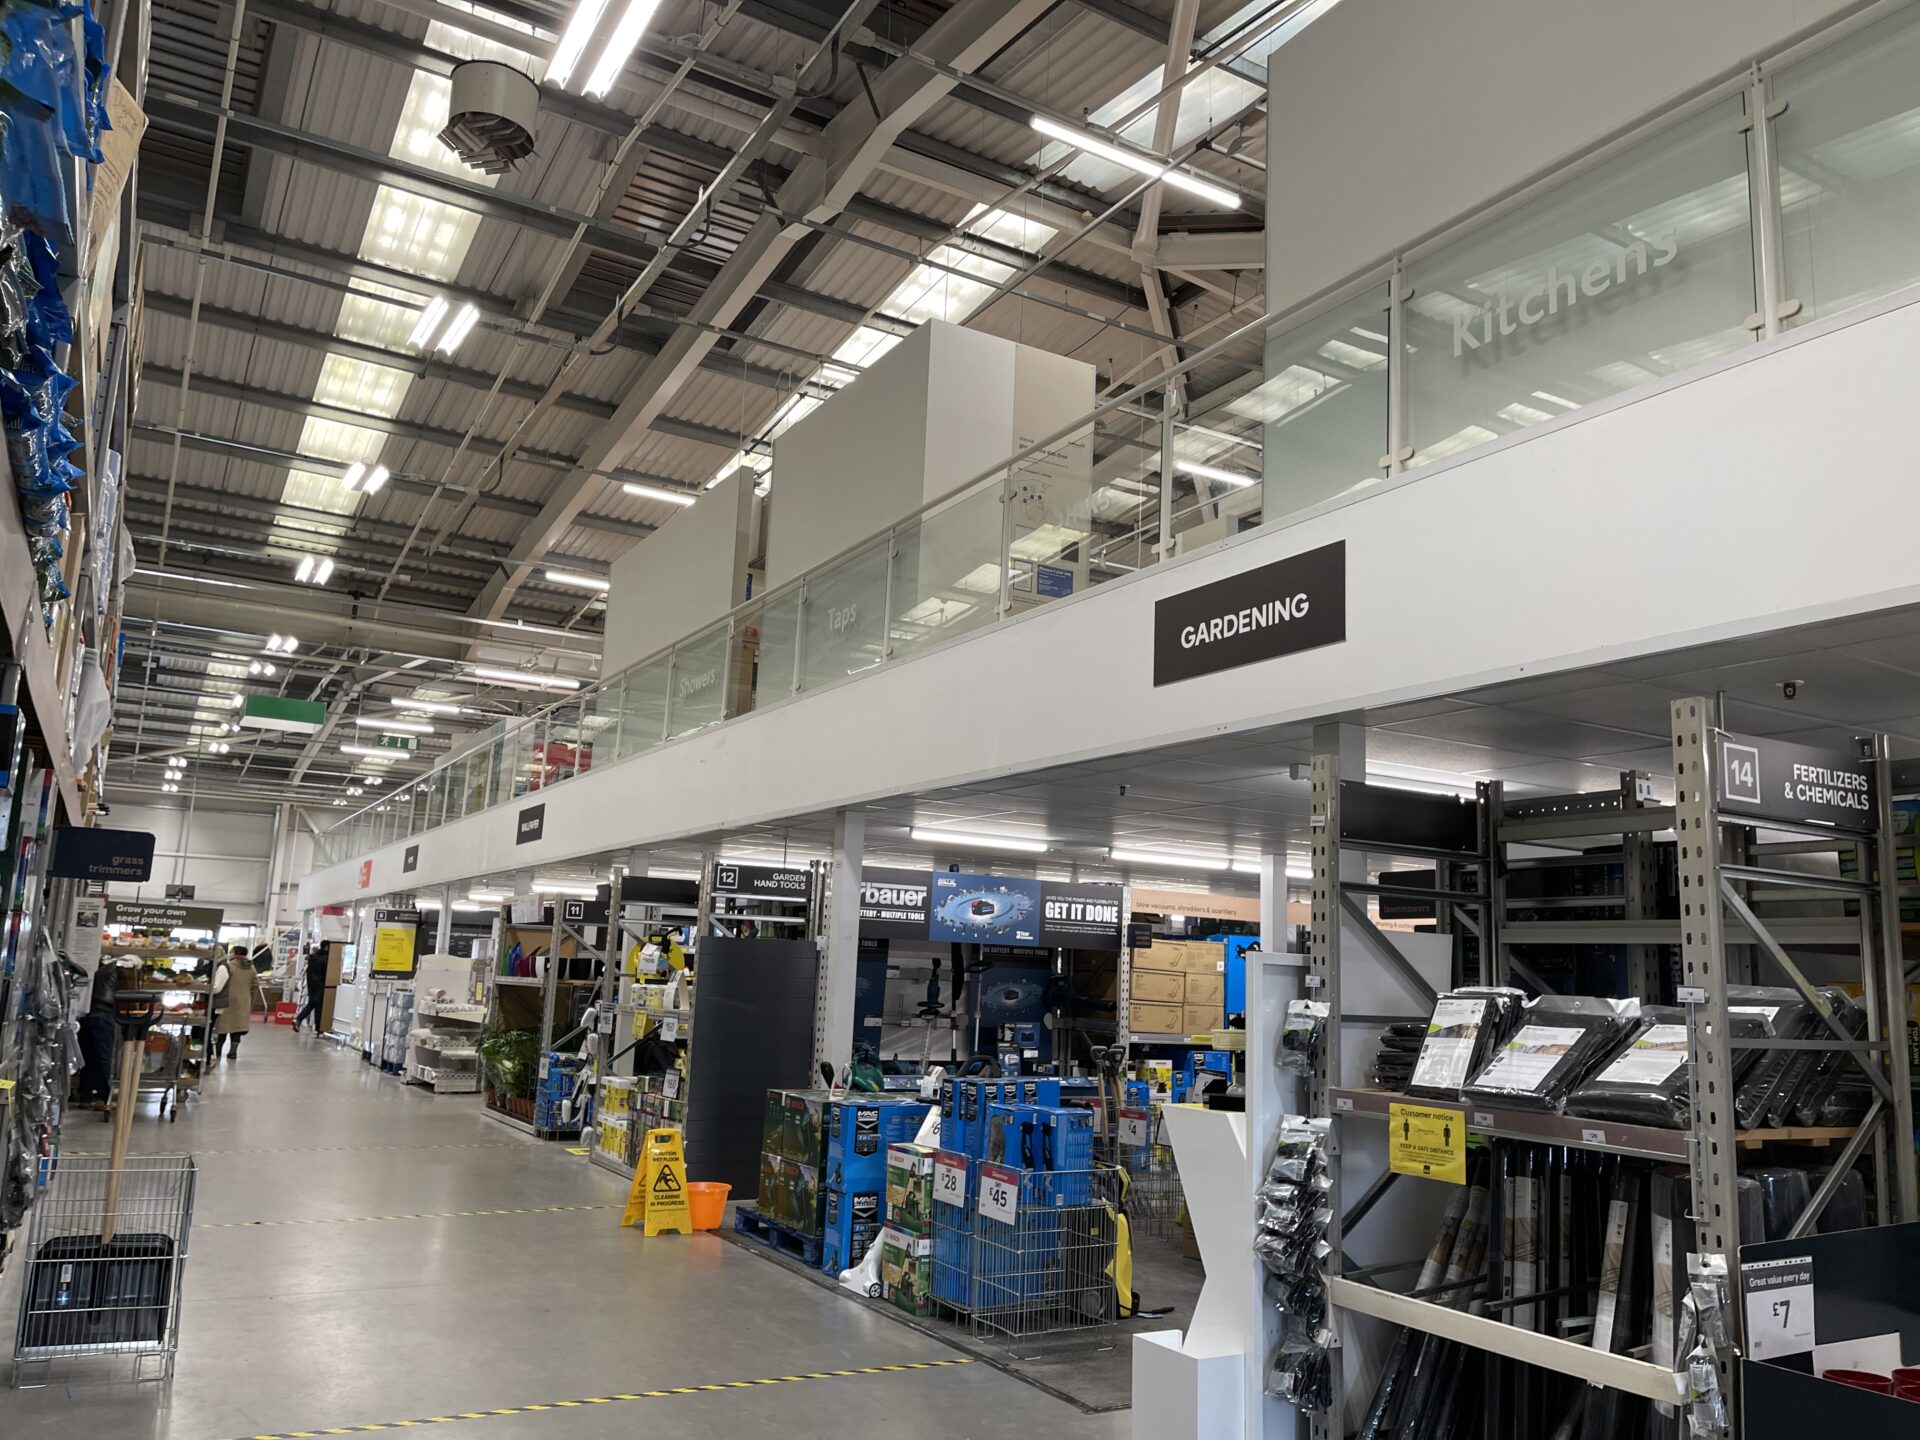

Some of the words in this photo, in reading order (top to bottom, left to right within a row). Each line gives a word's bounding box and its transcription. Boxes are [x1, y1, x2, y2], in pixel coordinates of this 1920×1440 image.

[1453, 227, 1678, 358] Kitchens
[827, 603, 857, 633] Taps
[1181, 593, 1309, 649] GARDENING
[679, 668, 716, 698] Showers
[1731, 760, 1753, 787] 14
[1793, 763, 1868, 791] FERTILIZERS
[1784, 782, 1794, 799] &
[1796, 785, 1870, 811] CHEMICALS
[112, 856, 144, 866] grass
[89, 864, 143, 876] trimmers
[720, 872, 735, 884] 12
[772, 873, 806, 882] GARDEN
[753, 880, 778, 888] HAND
[779, 881, 806, 890] TOOLS
[116, 904, 142, 914] Grow
[143, 906, 165, 916] your
[166, 908, 187, 916] own
[570, 905, 580, 915] 11
[881, 910, 907, 920] MULTIPLE
[907, 912, 925, 921] TOOLS
[1045, 901, 1069, 919] GET
[1070, 903, 1083, 920] IT
[1085, 904, 1119, 923] DONE
[1177, 905, 1206, 913] shredders
[1211, 908, 1237, 916] scarifiers
[1383, 904, 1430, 913] lawnmowers
[116, 914, 139, 923] seed
[141, 915, 183, 926] potatoes
[1016, 930, 1021, 940] 3
[1912, 1043, 1920, 1065] LAWN
[1400, 1108, 1432, 1119] Customer
[1432, 1113, 1454, 1122] notice
[1429, 1147, 1454, 1155] DISTANCE
[941, 1173, 957, 1191] £28
[989, 1187, 1007, 1207] £45
[1749, 1277, 1767, 1287] Great
[1767, 1274, 1782, 1285] value
[1783, 1273, 1799, 1284] every
[1799, 1271, 1810, 1282] day
[1772, 1300, 1791, 1329] £7
